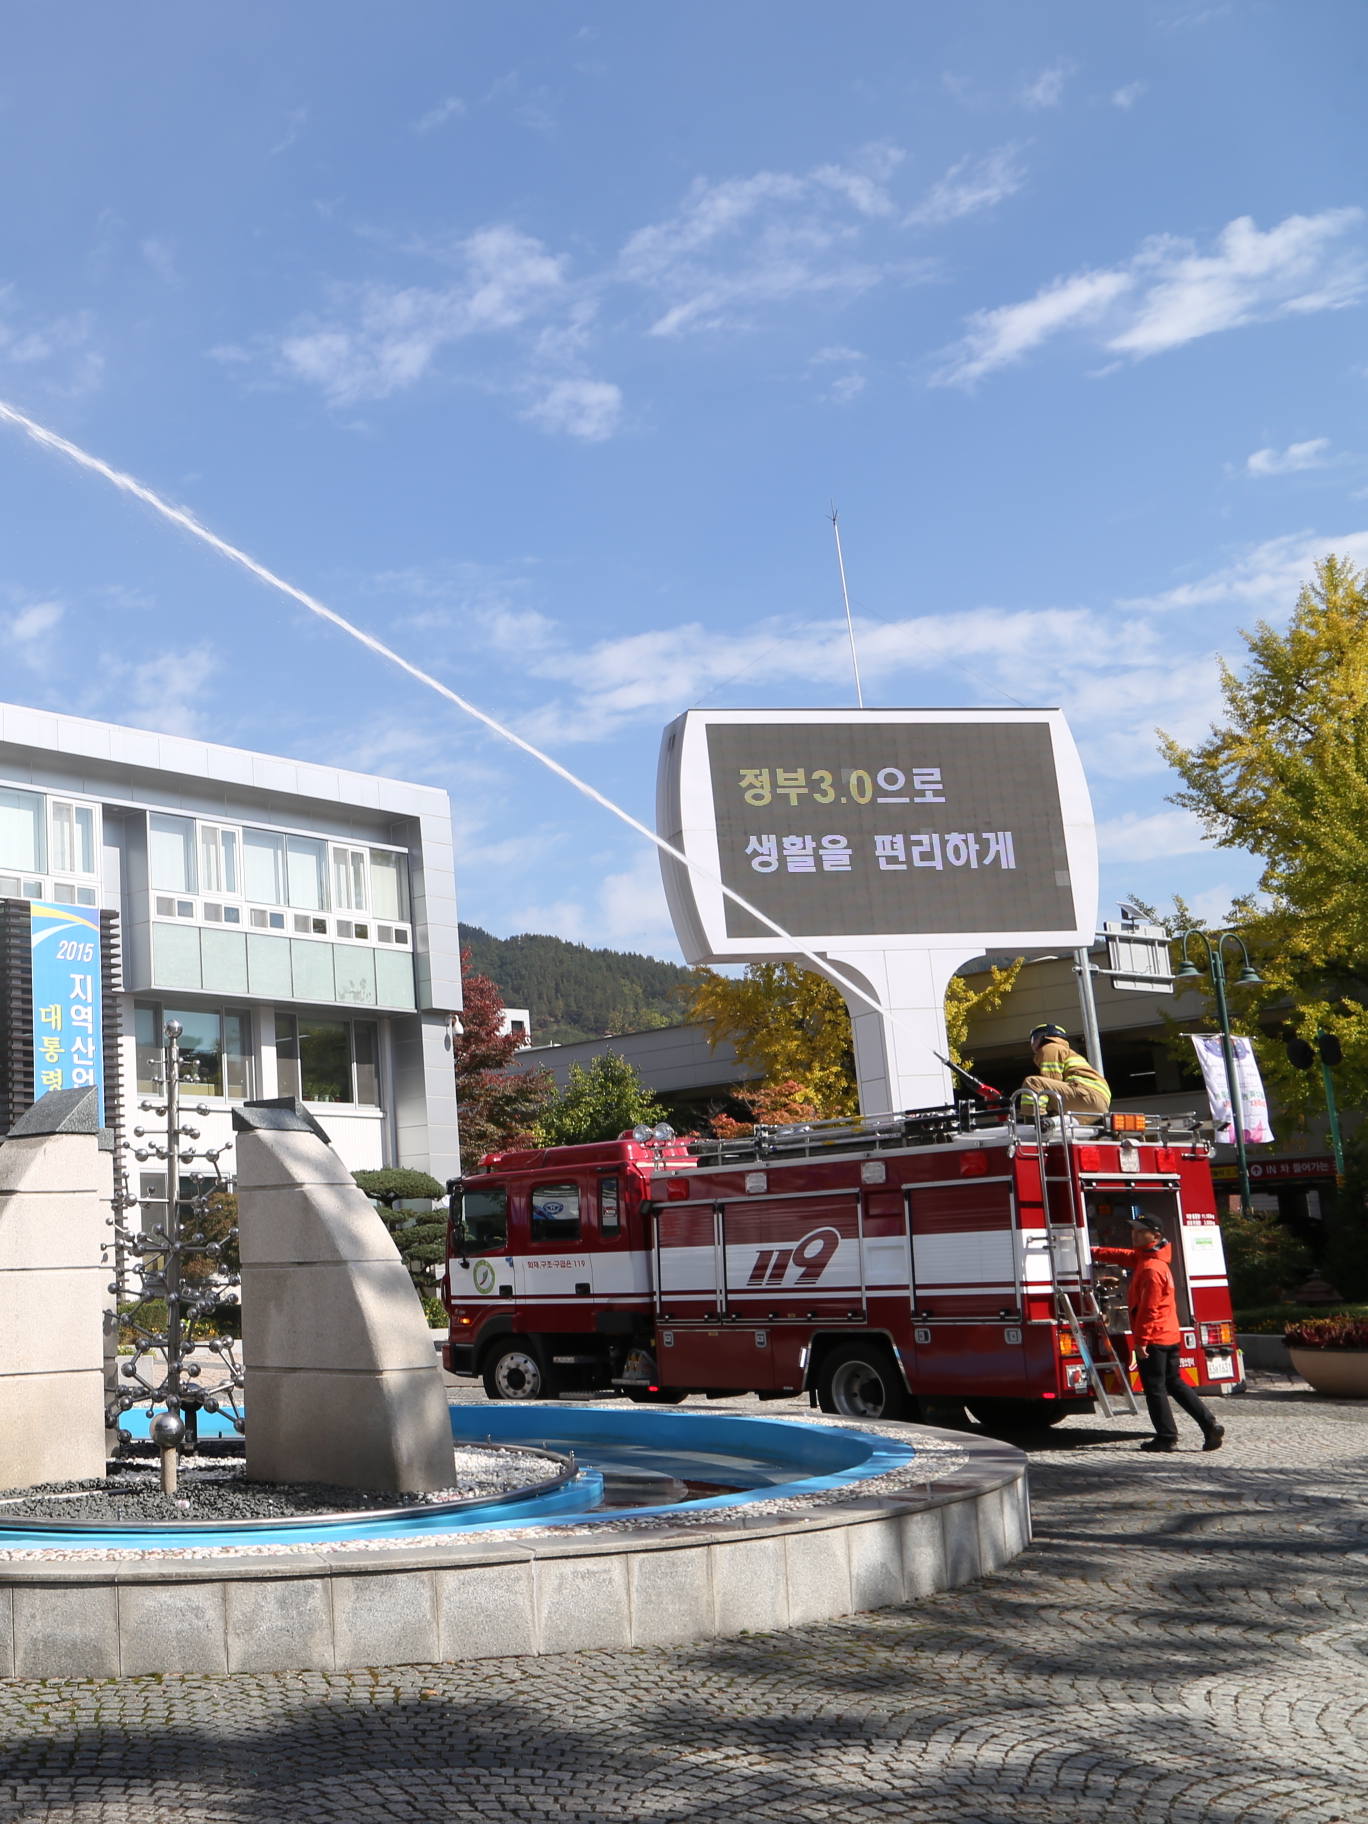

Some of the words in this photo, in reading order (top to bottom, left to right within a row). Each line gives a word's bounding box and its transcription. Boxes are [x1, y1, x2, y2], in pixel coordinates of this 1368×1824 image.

[738, 767, 946, 806] 정부3.0으로
[744, 834, 853, 874] 생활을
[874, 831, 1016, 871] 편리하게
[56, 939, 95, 963] 2015
[39, 1004, 66, 1092] 대통령
[1266, 1165, 1277, 1174] IN
[1280, 1163, 1289, 1173] 차
[1293, 1161, 1329, 1173] 들어가는
[573, 1260, 586, 1268] 119
[746, 1228, 840, 1286] 119
